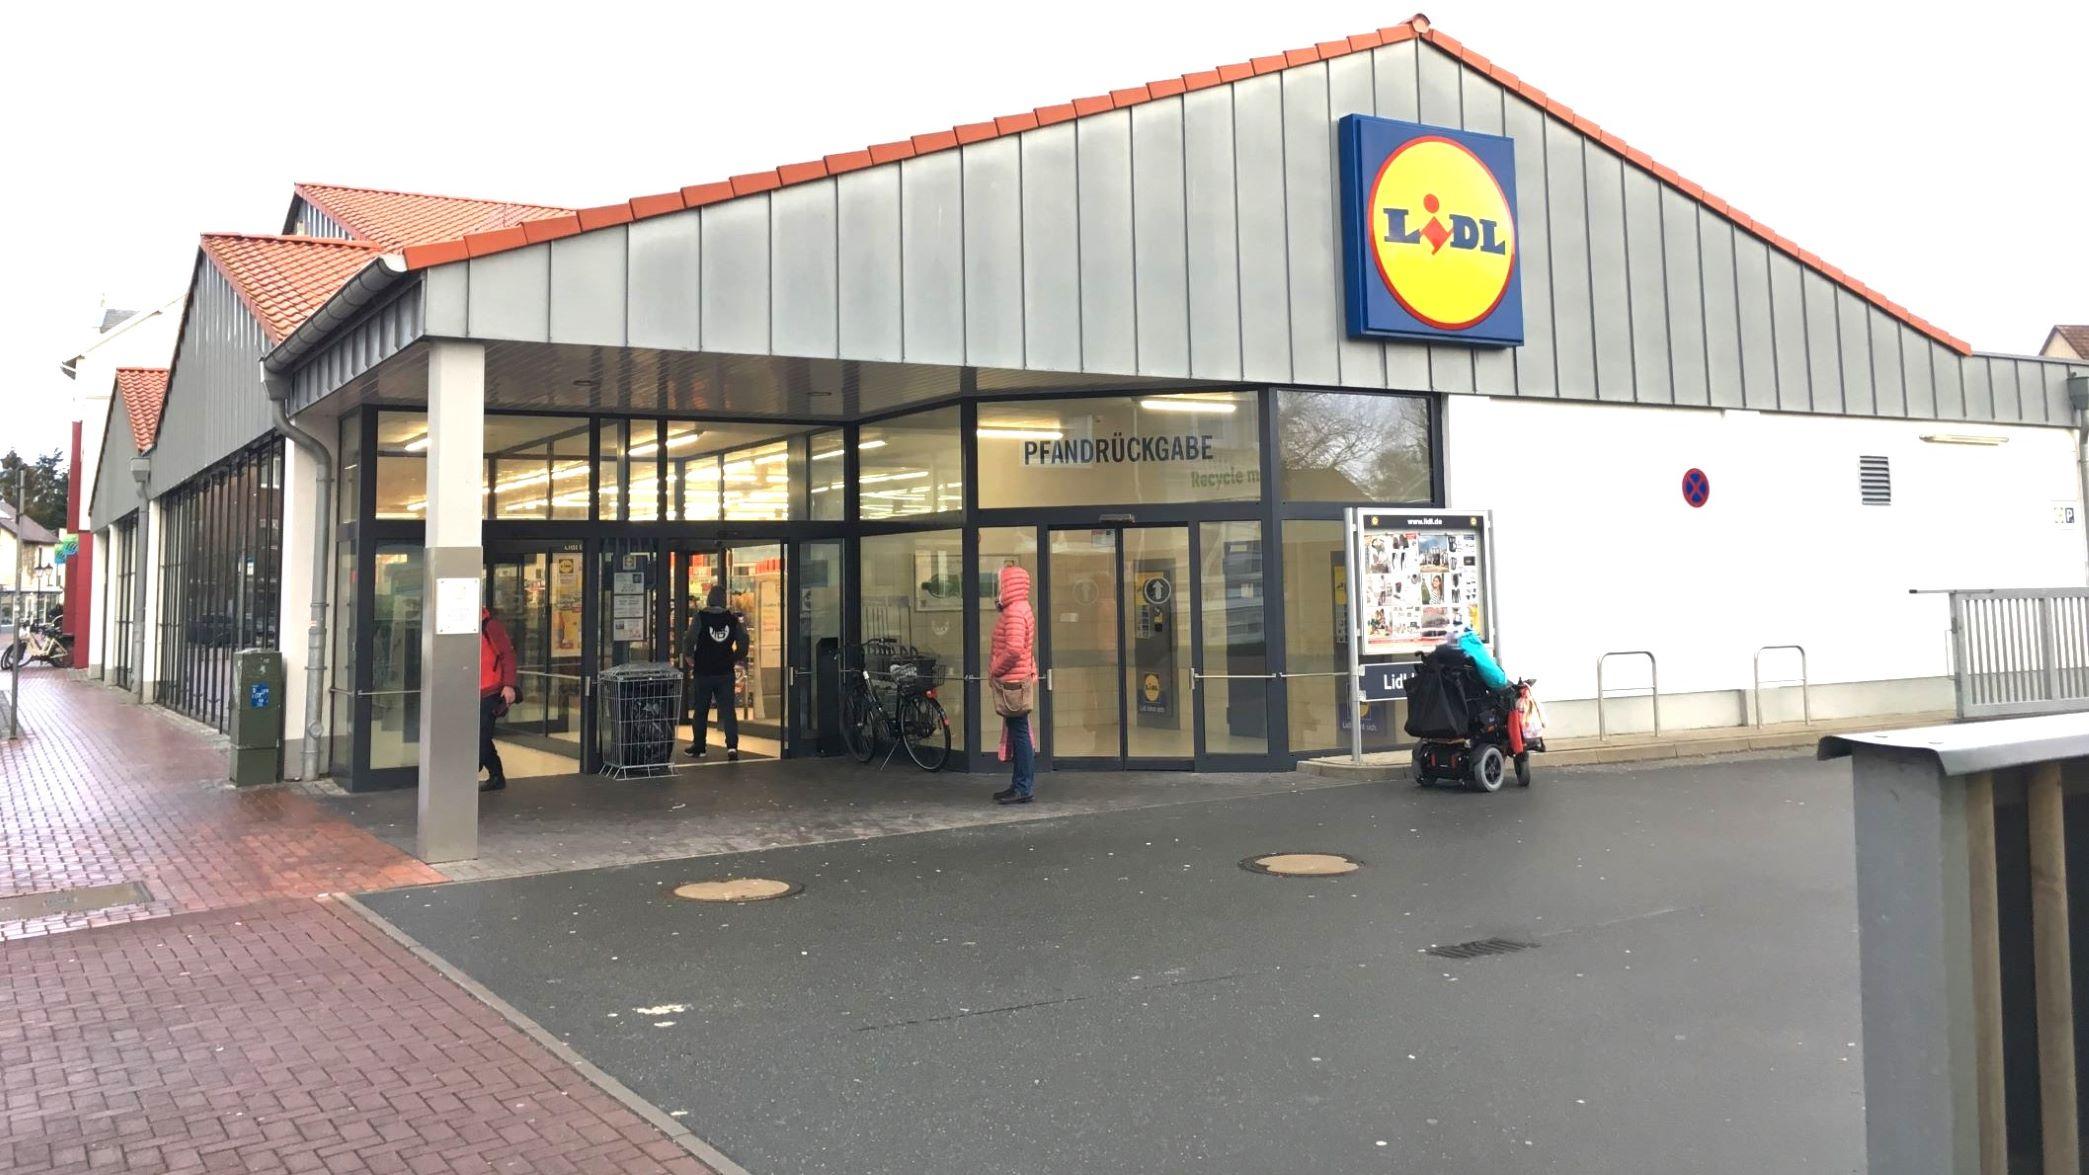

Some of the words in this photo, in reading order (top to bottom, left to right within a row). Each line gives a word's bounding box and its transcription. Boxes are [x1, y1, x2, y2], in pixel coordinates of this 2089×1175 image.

[1383, 194, 1506, 256] LIDL
[1024, 433, 1214, 465] PFANDRÜCKGABE
[1191, 467, 1243, 490] Recycle
